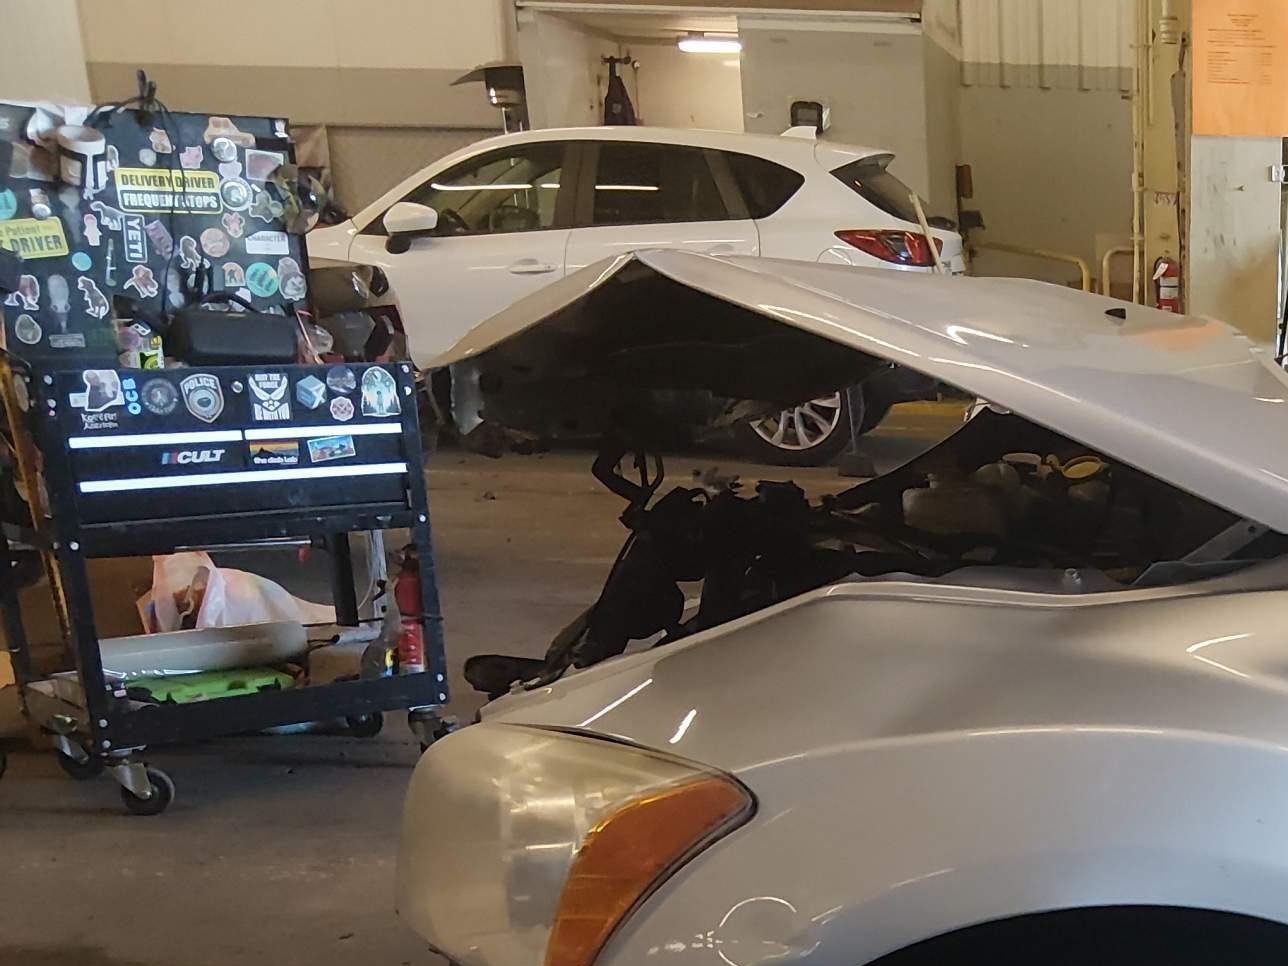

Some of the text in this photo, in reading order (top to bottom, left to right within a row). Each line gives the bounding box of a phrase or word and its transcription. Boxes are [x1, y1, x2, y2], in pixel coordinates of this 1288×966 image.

[121, 174, 215, 189] DELIVERY DRIVER
[10, 235, 63, 253] DRIVER
[127, 219, 143, 258] YETI
[184, 376, 217, 394] POLICE
[122, 378, 142, 415] OCB
[177, 449, 225, 464] CULT
